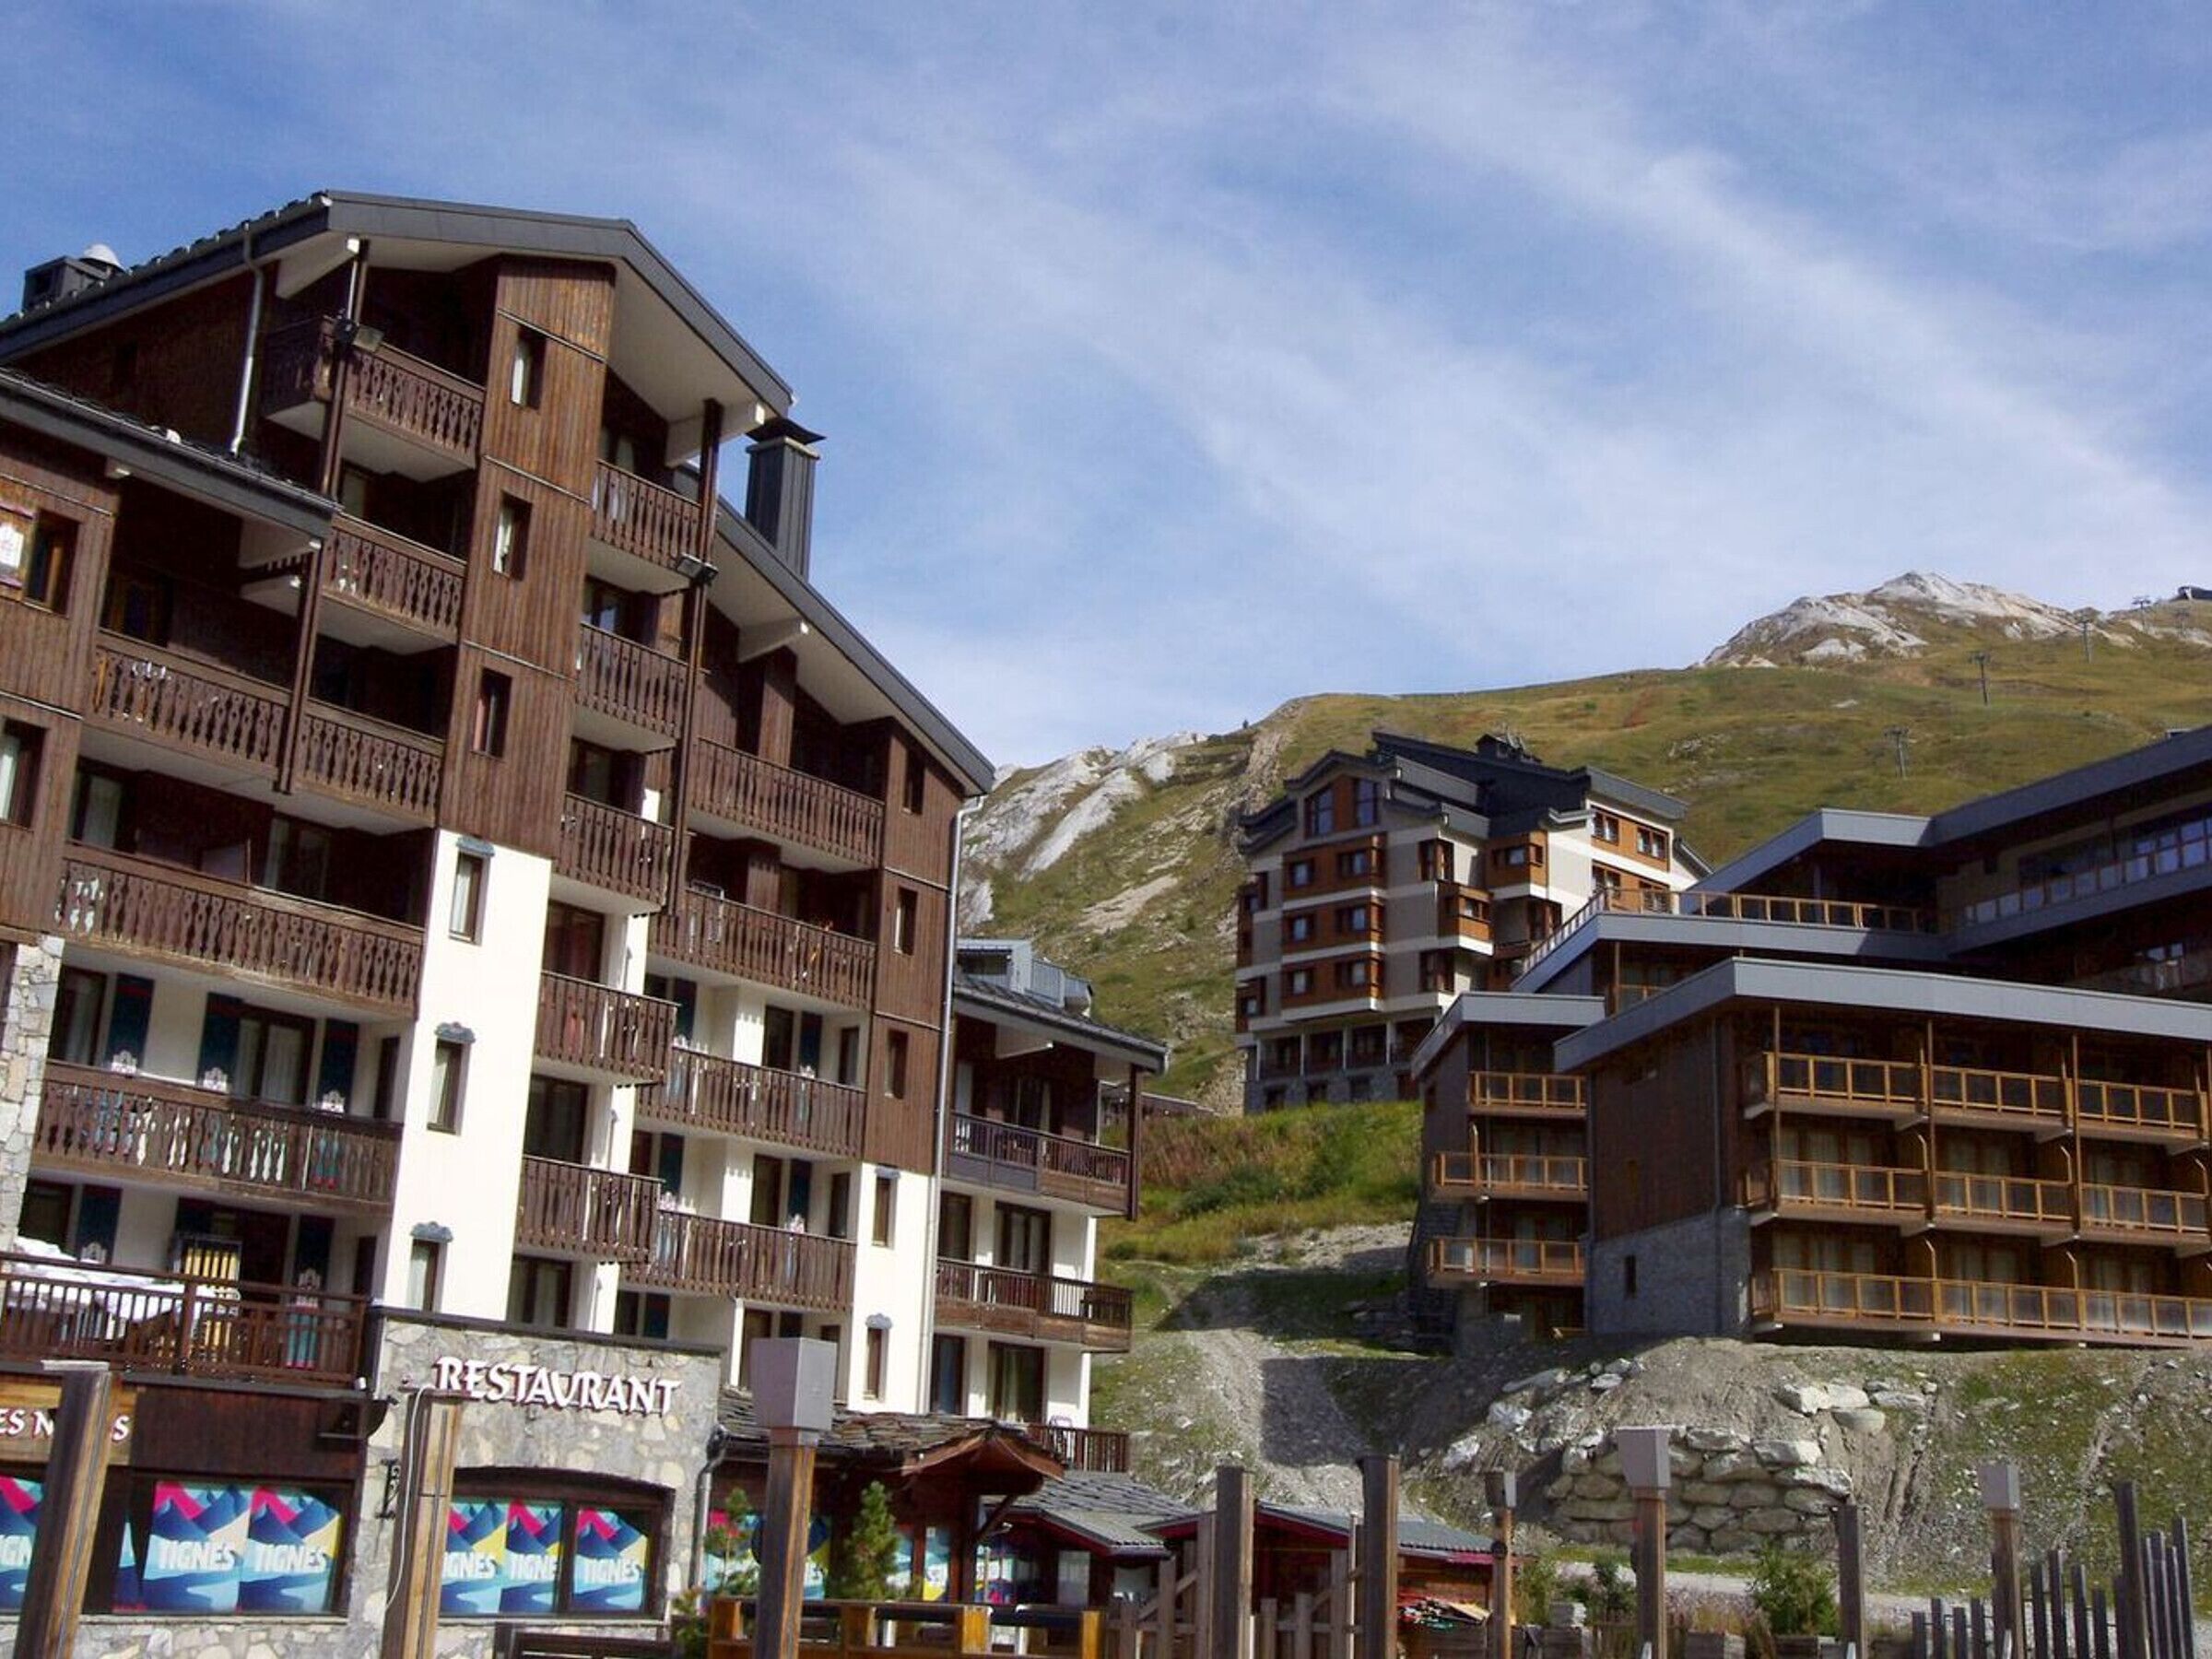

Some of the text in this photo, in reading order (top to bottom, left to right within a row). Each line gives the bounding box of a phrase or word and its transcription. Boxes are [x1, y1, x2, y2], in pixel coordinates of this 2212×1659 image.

[435, 1356, 681, 1417] RESTAURANT
[159, 1540, 235, 1571] TIGNES
[254, 1544, 326, 1572] TIGNES
[584, 1558, 641, 1584] TIGNES
